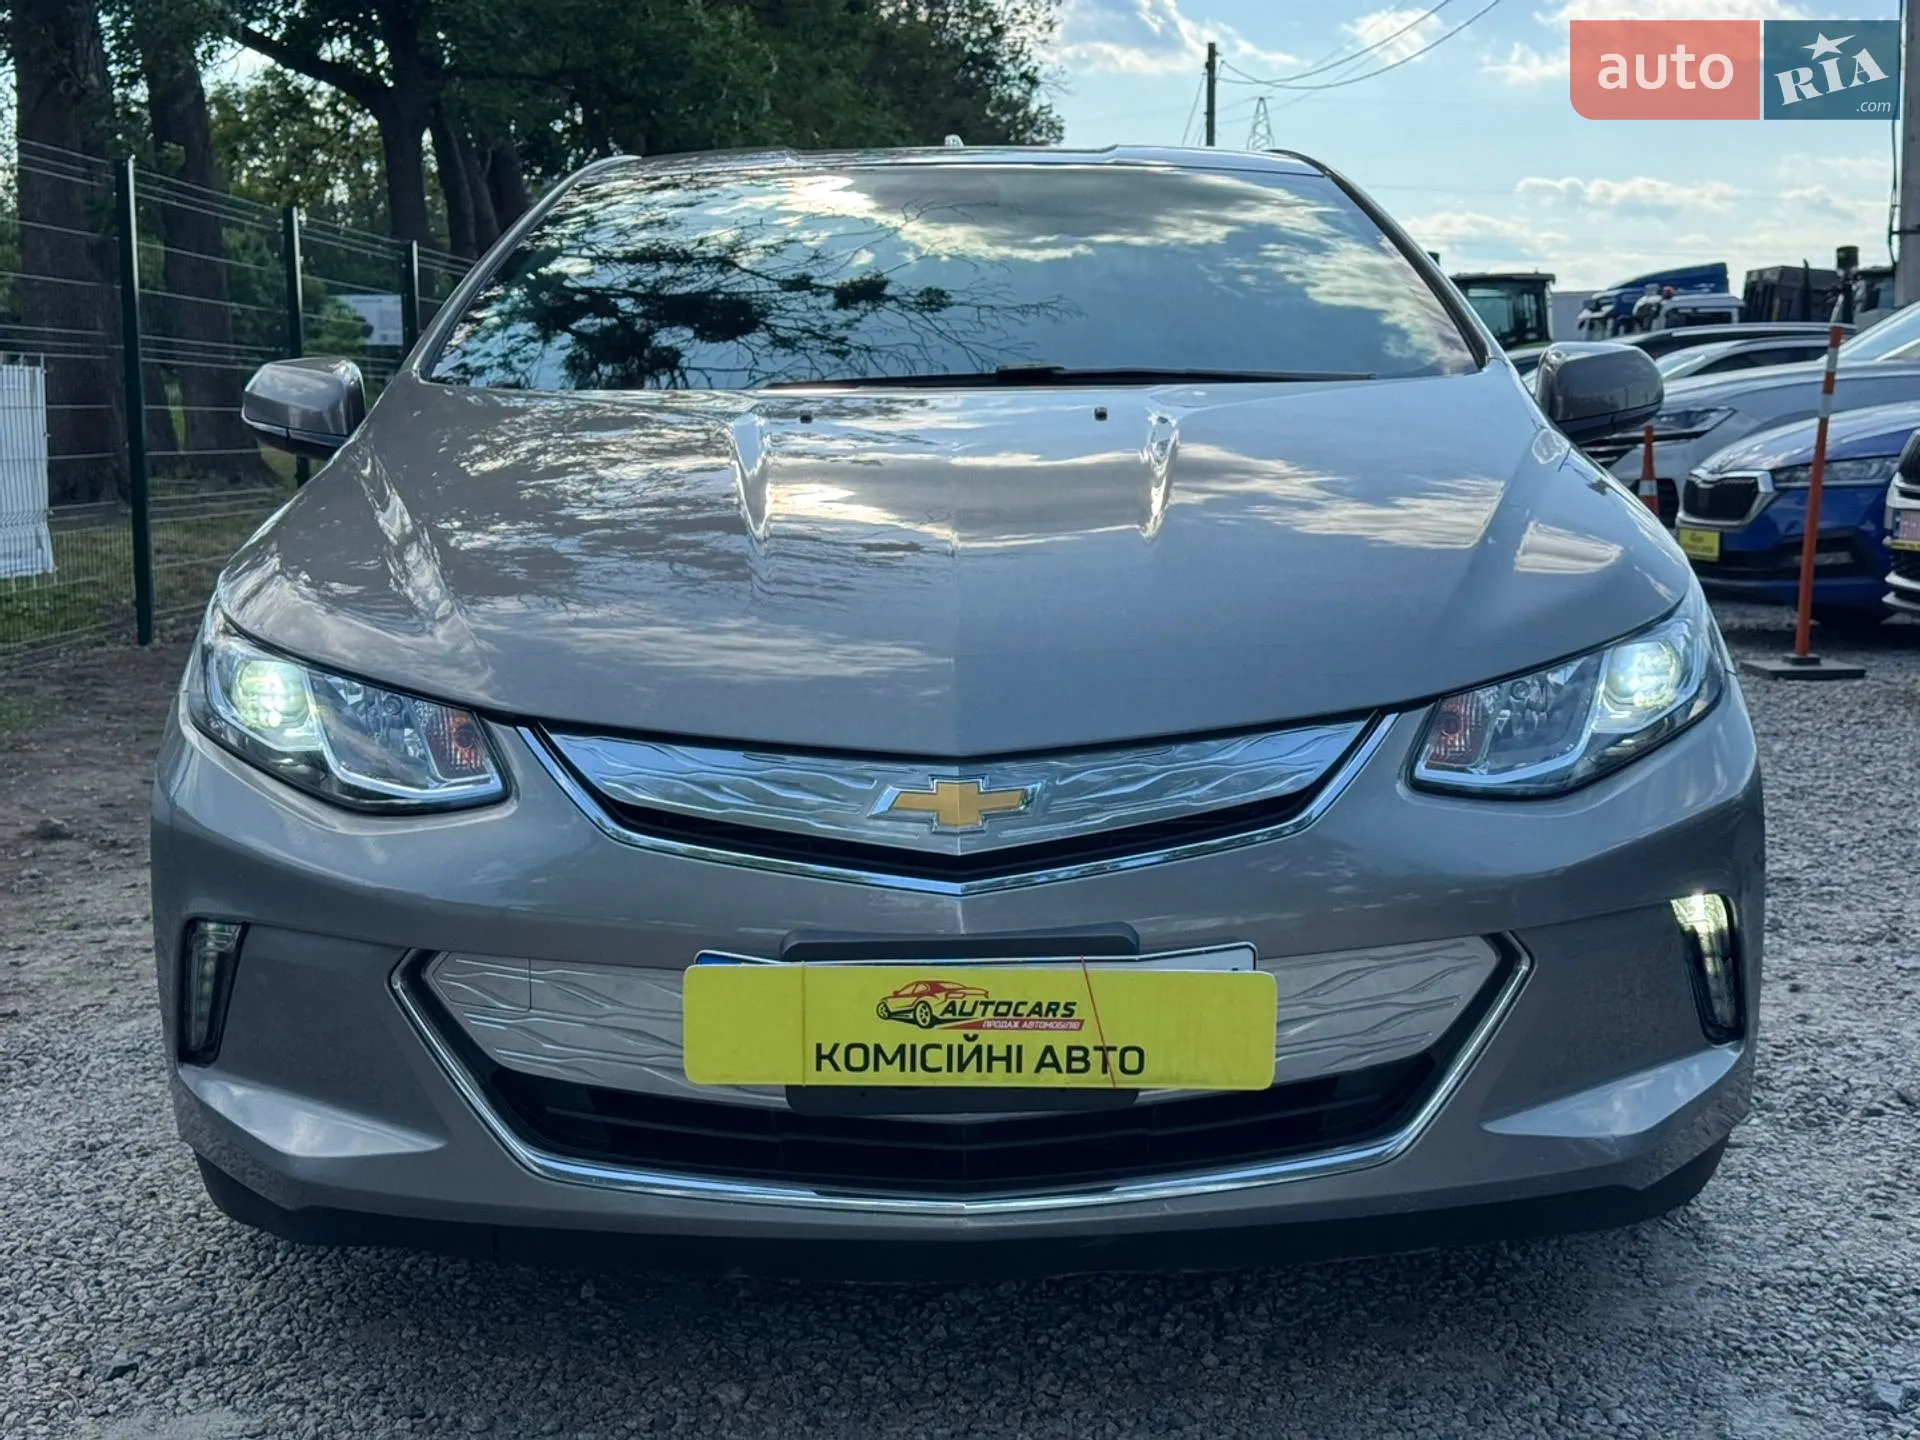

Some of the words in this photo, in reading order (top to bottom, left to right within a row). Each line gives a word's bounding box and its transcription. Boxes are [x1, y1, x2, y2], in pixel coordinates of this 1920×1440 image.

[940, 1000, 1077, 1017] AUTOCARS
[982, 1020, 1021, 1029] ПРОДАЖ
[815, 1033, 1023, 1075] КОМІСІЙНІ
[1034, 1044, 1146, 1075] АВТО
